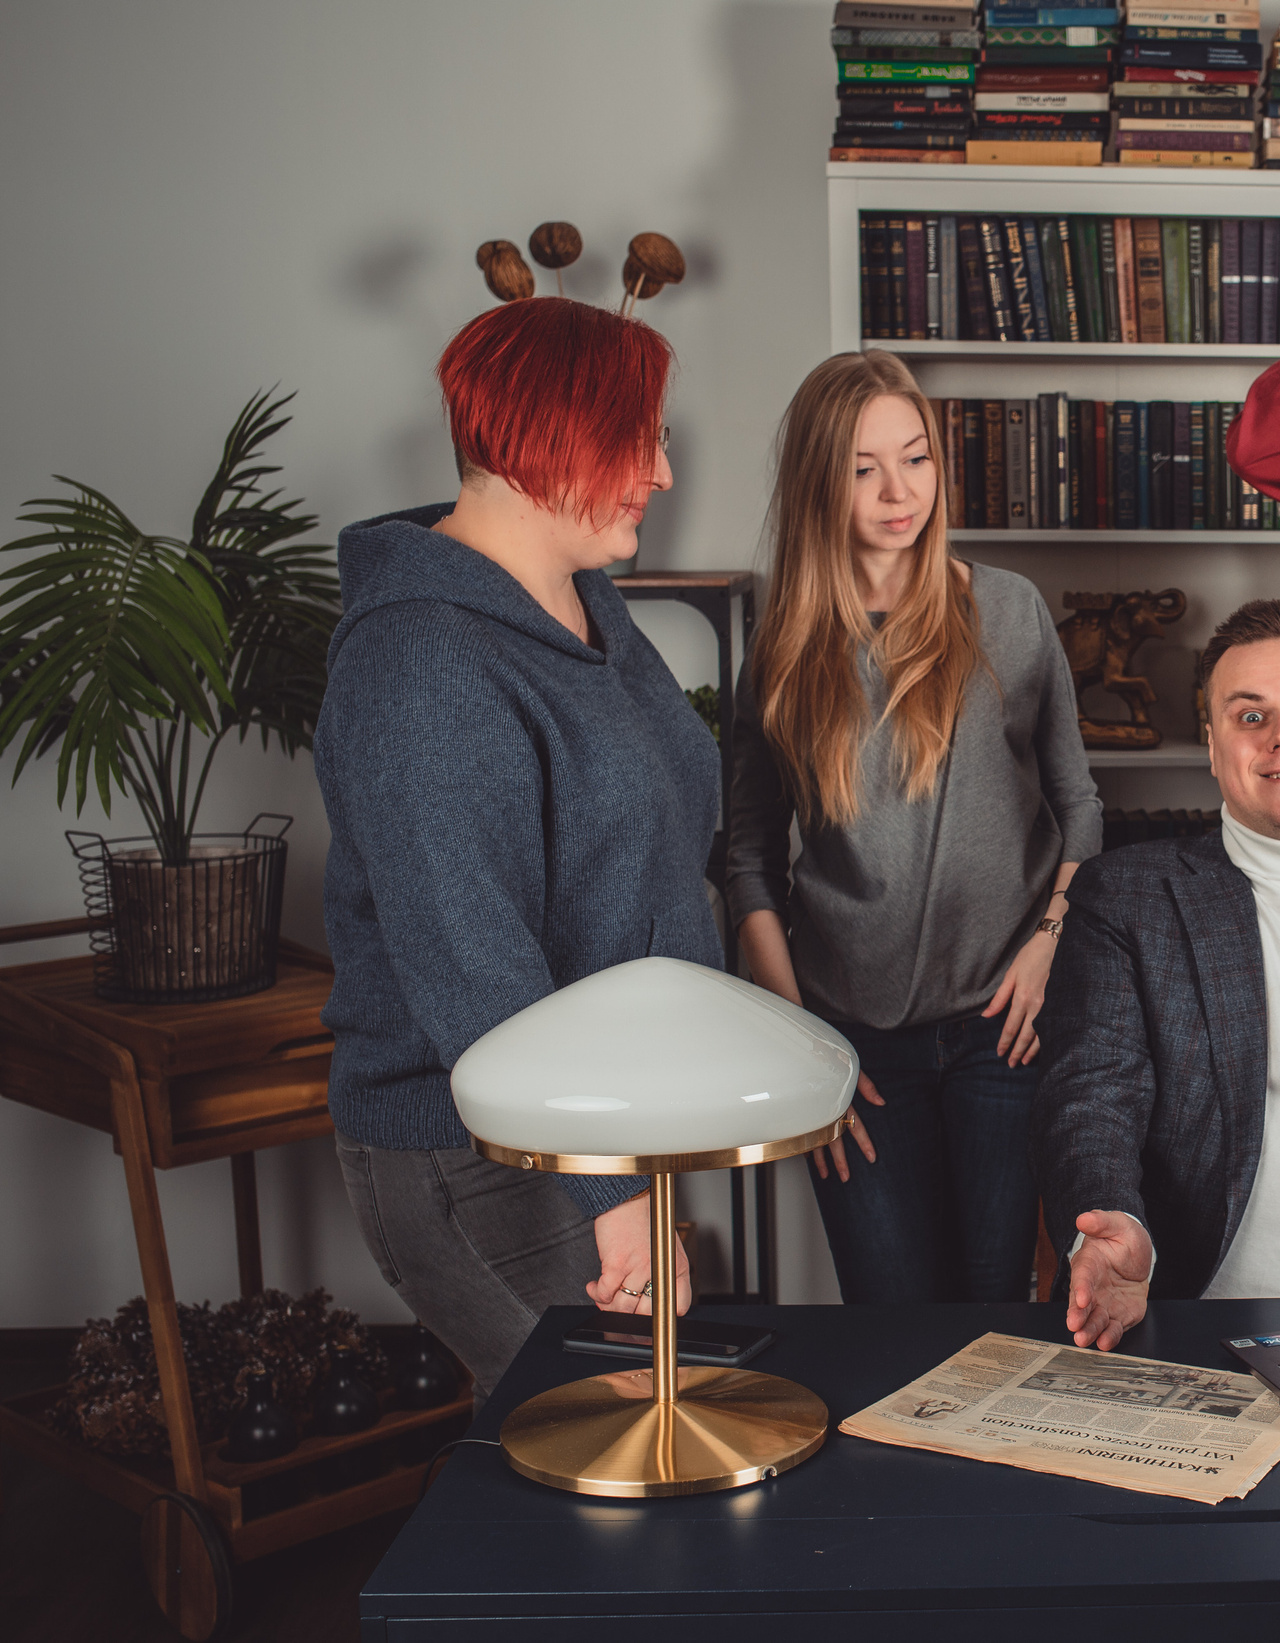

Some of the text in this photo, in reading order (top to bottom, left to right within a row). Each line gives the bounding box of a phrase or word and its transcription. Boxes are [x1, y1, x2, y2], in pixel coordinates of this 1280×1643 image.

[981, 1417, 1090, 1438] construction
[1093, 1434, 1156, 1449] freezes
[1157, 1443, 1197, 1455] plan
[1077, 1447, 1204, 1472] KATHIMERINI
[1198, 1450, 1235, 1461] VAT
